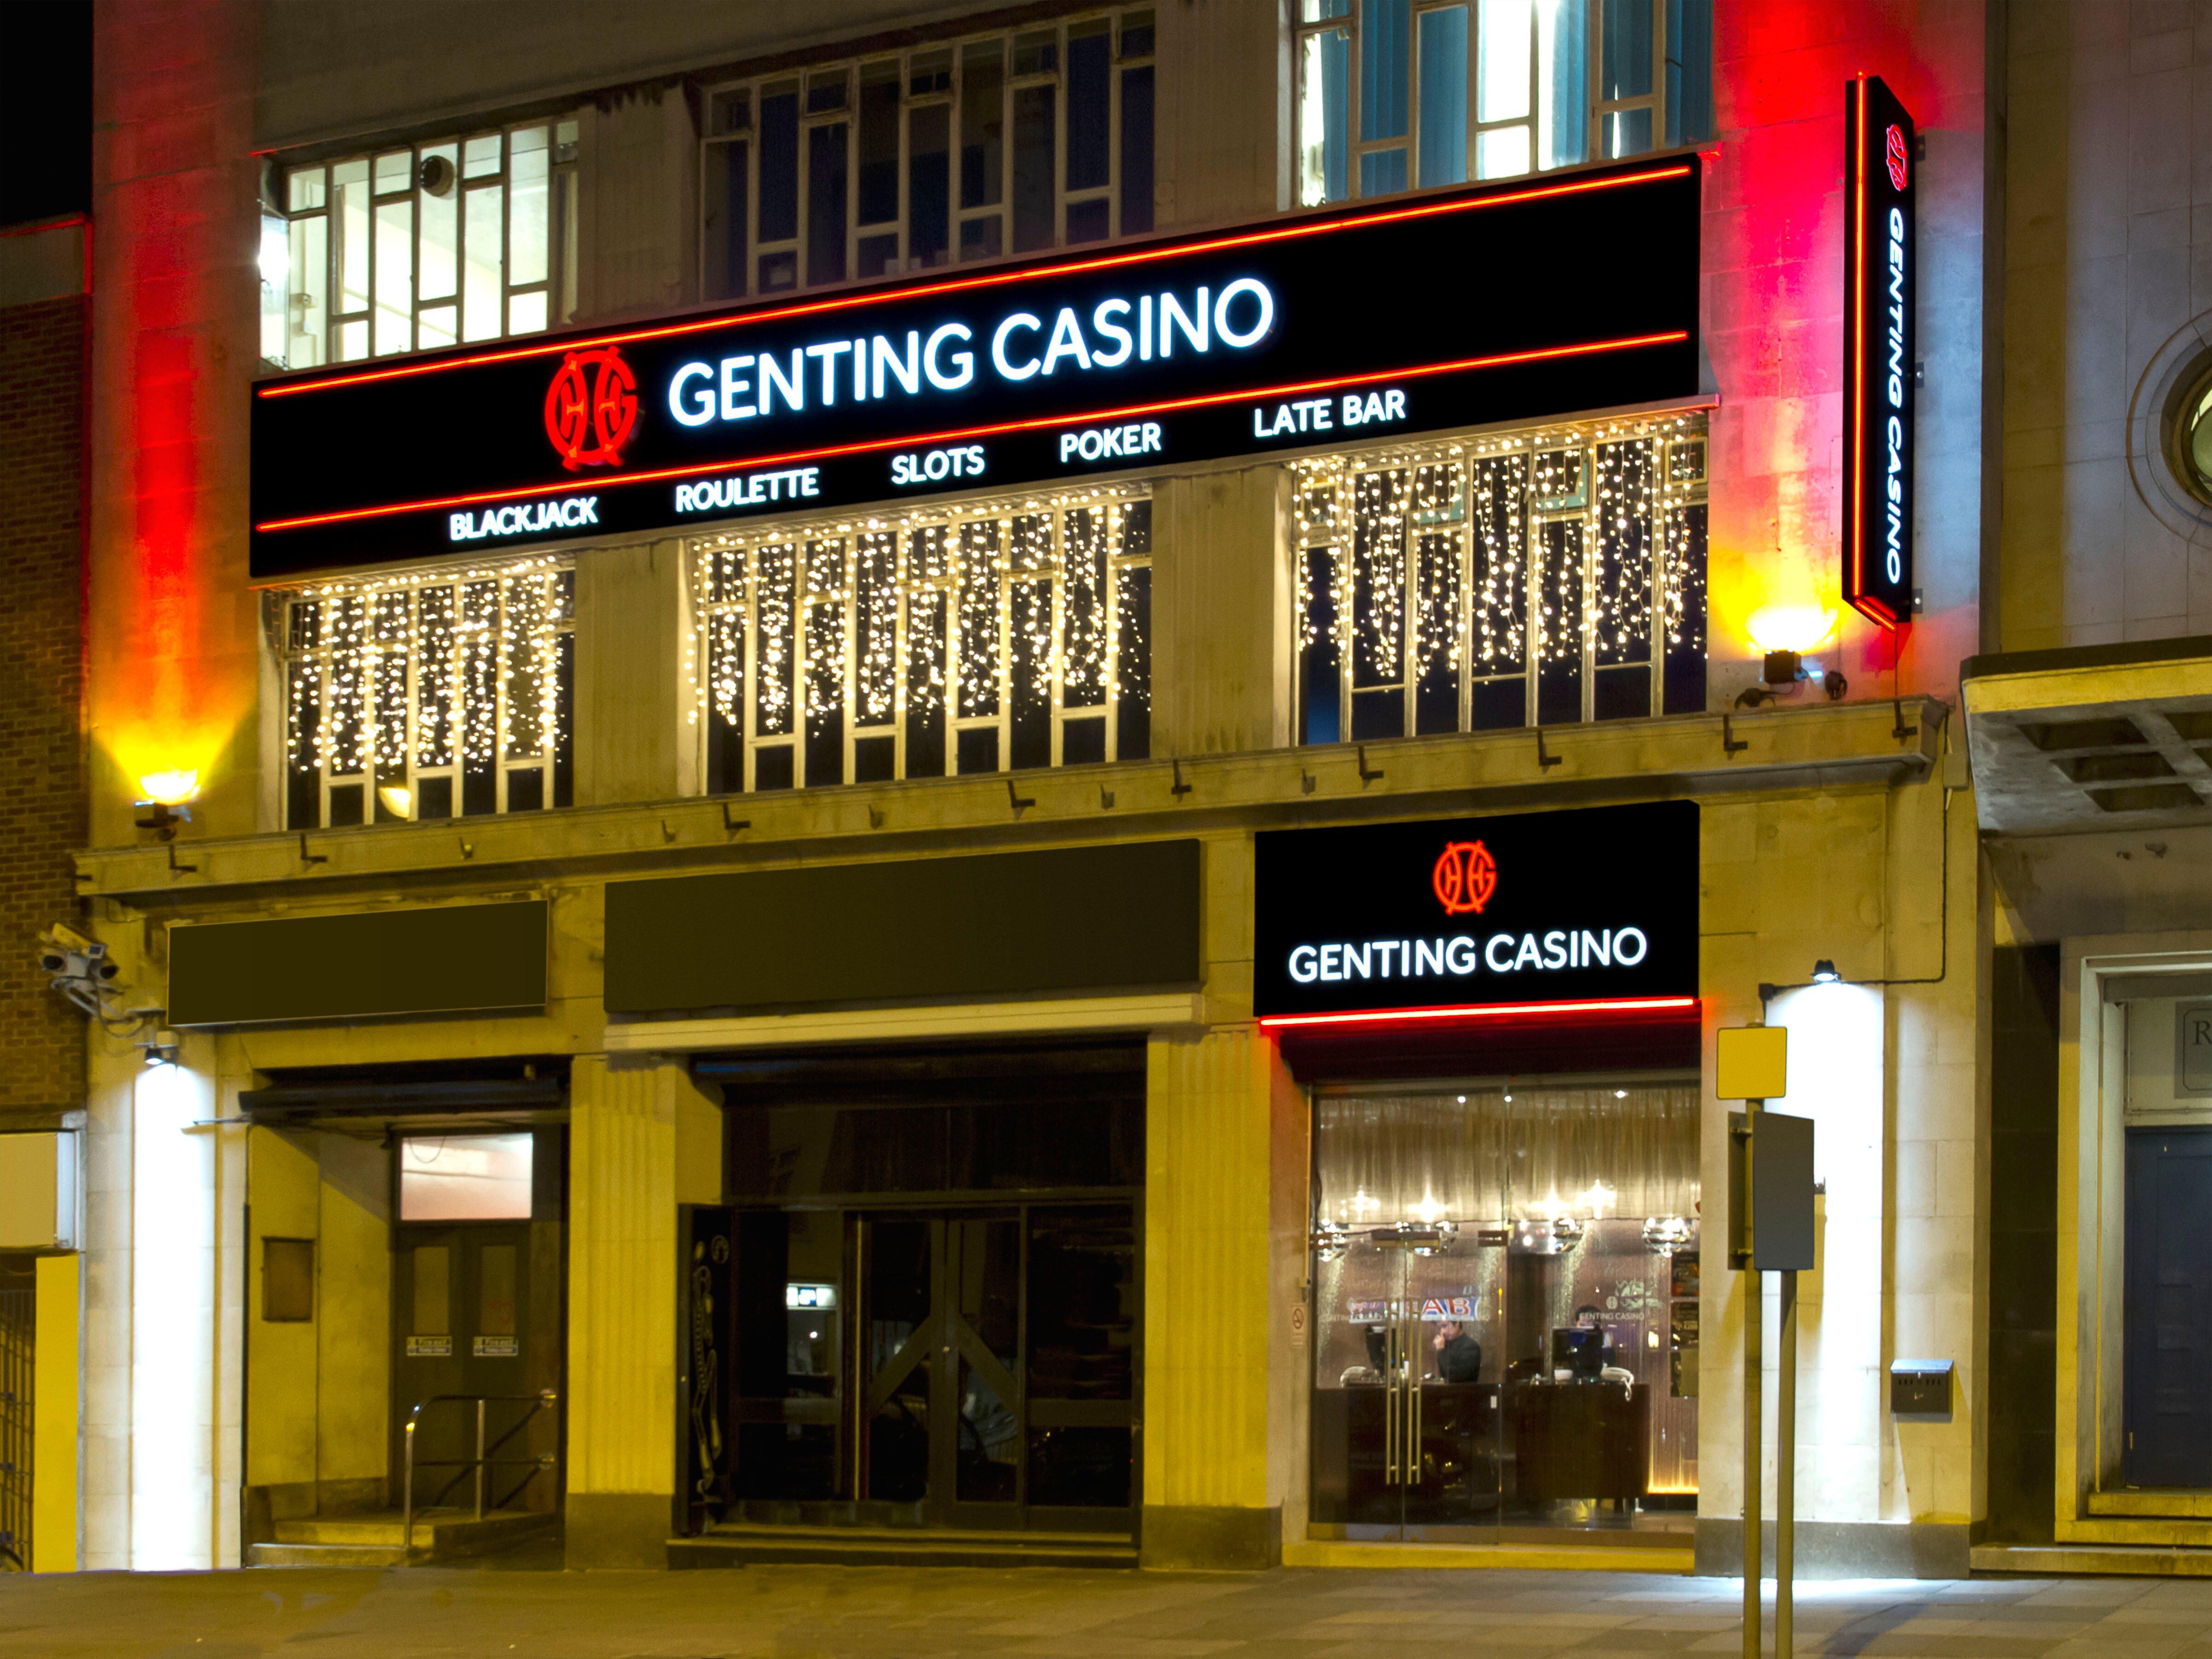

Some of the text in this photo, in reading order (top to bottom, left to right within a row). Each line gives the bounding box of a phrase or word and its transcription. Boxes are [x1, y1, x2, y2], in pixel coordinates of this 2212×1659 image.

[1888, 207, 1904, 408] GENTING
[668, 322, 974, 427] GENTING
[992, 277, 1274, 381] CASINO
[1254, 389, 1406, 437] LATE BAR
[891, 445, 985, 485] SLOTS
[1060, 422, 1162, 463] POKER
[675, 467, 820, 512] ROULETTE
[1887, 415, 1903, 584] CASINO
[449, 496, 599, 541] BLACKJACK
[1288, 927, 1647, 983] GENTING CASINO
[1615, 1312, 1645, 1321] CASINO
